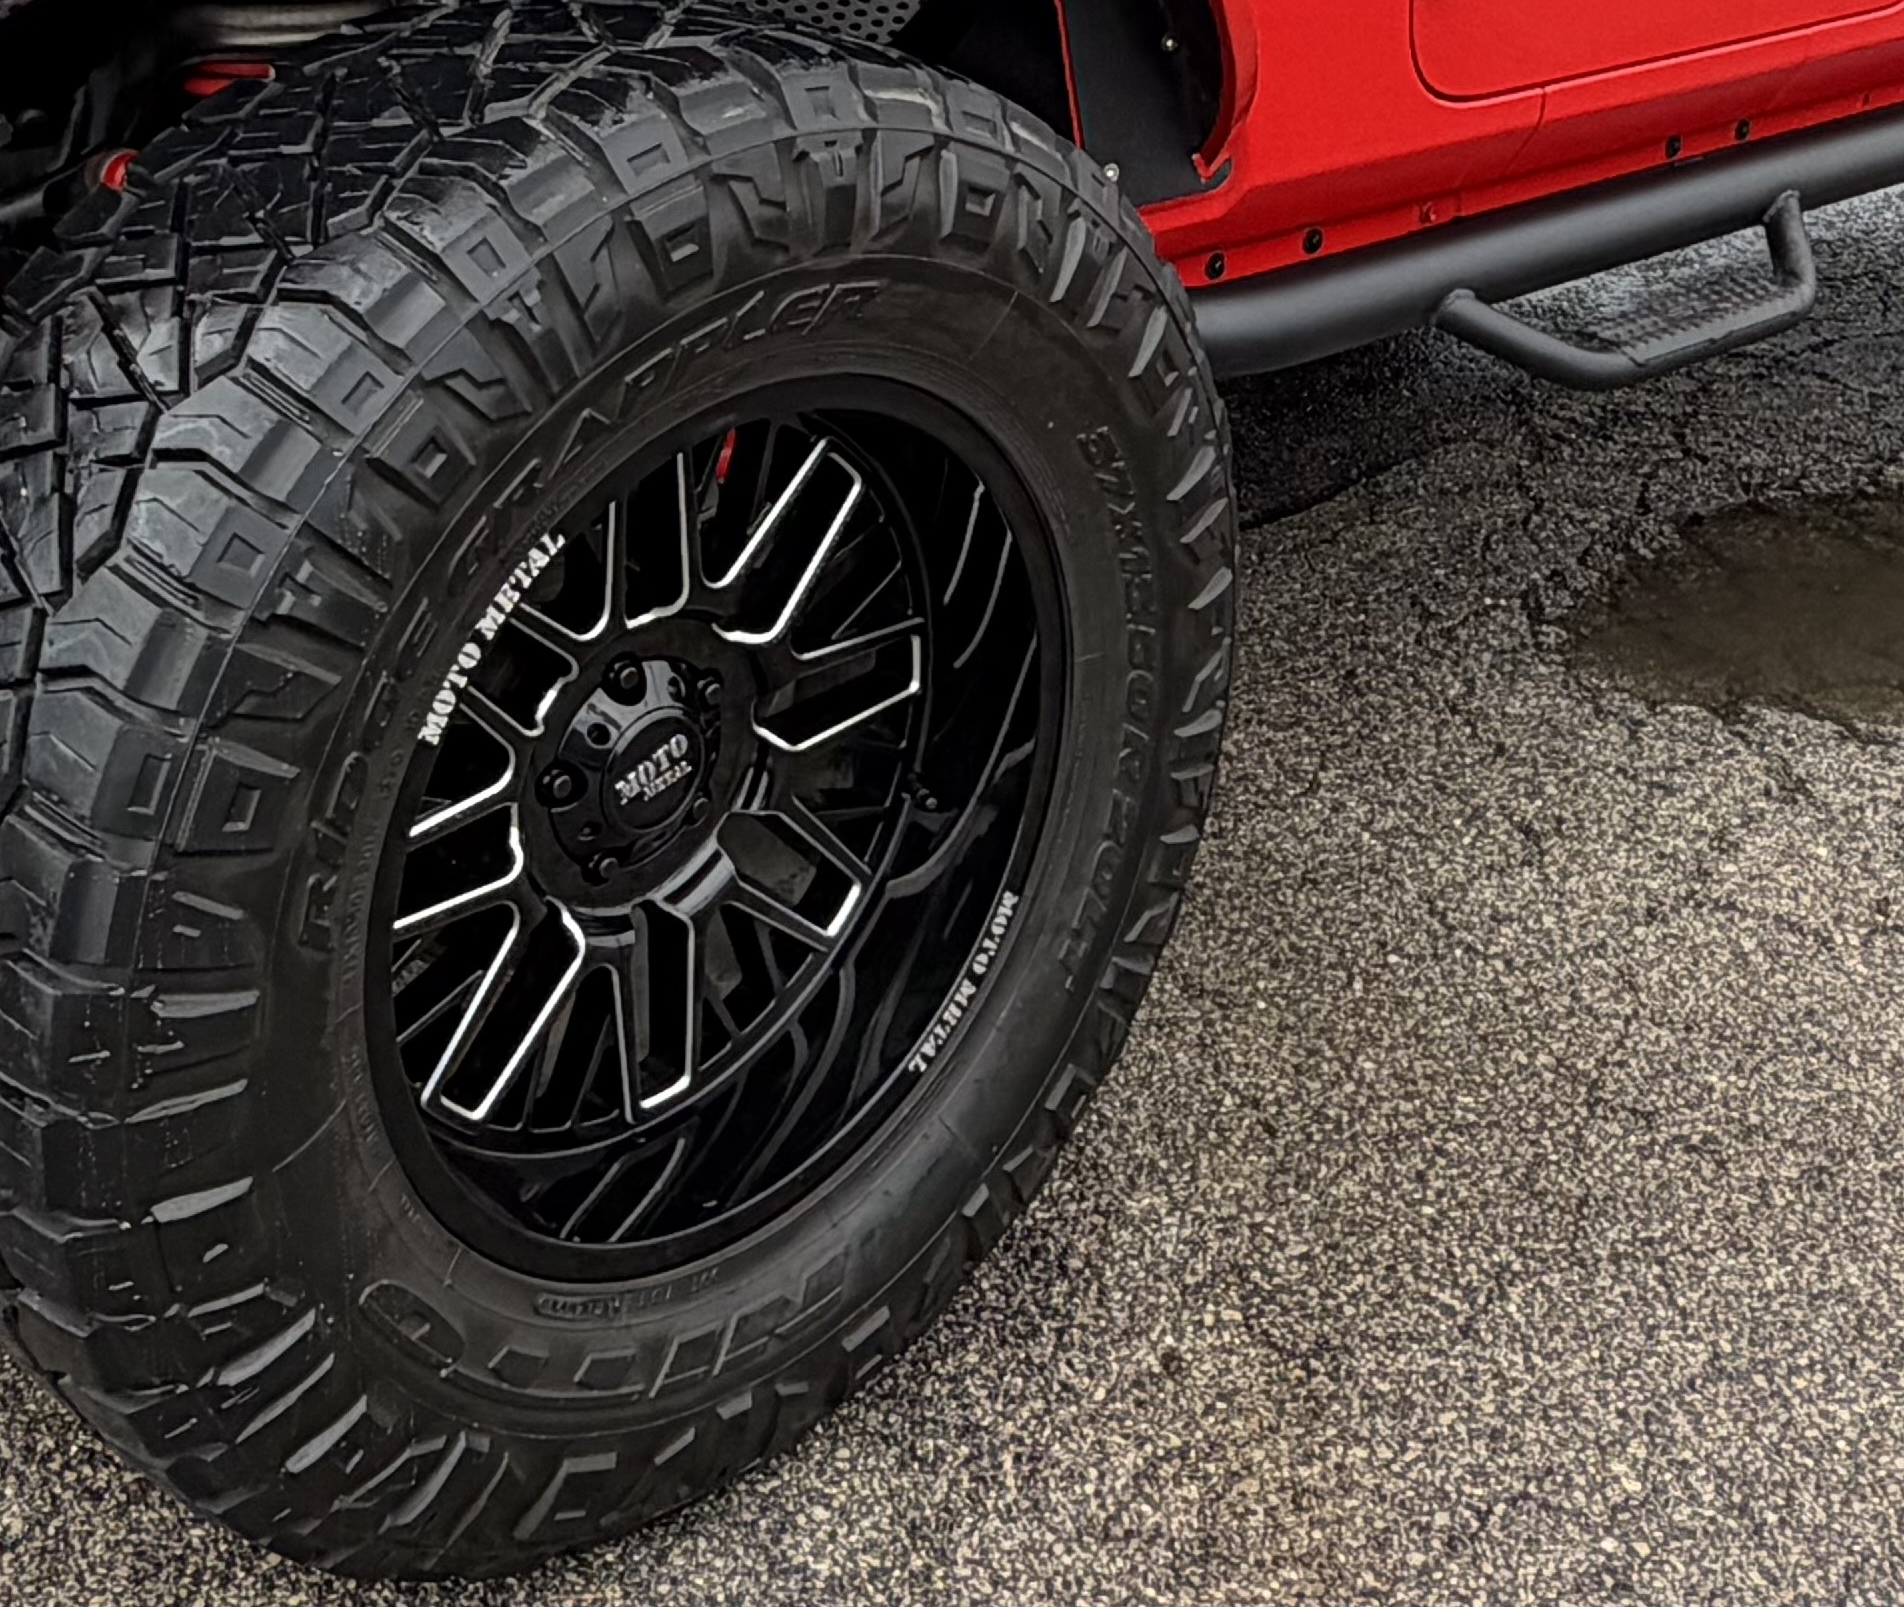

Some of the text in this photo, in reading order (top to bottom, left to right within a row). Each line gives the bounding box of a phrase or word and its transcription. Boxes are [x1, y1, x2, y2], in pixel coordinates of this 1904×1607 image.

[417, 533, 566, 746] MOTO METAL
[615, 734, 688, 806] MOTO
[908, 890, 1020, 1073] MOTO METAL
